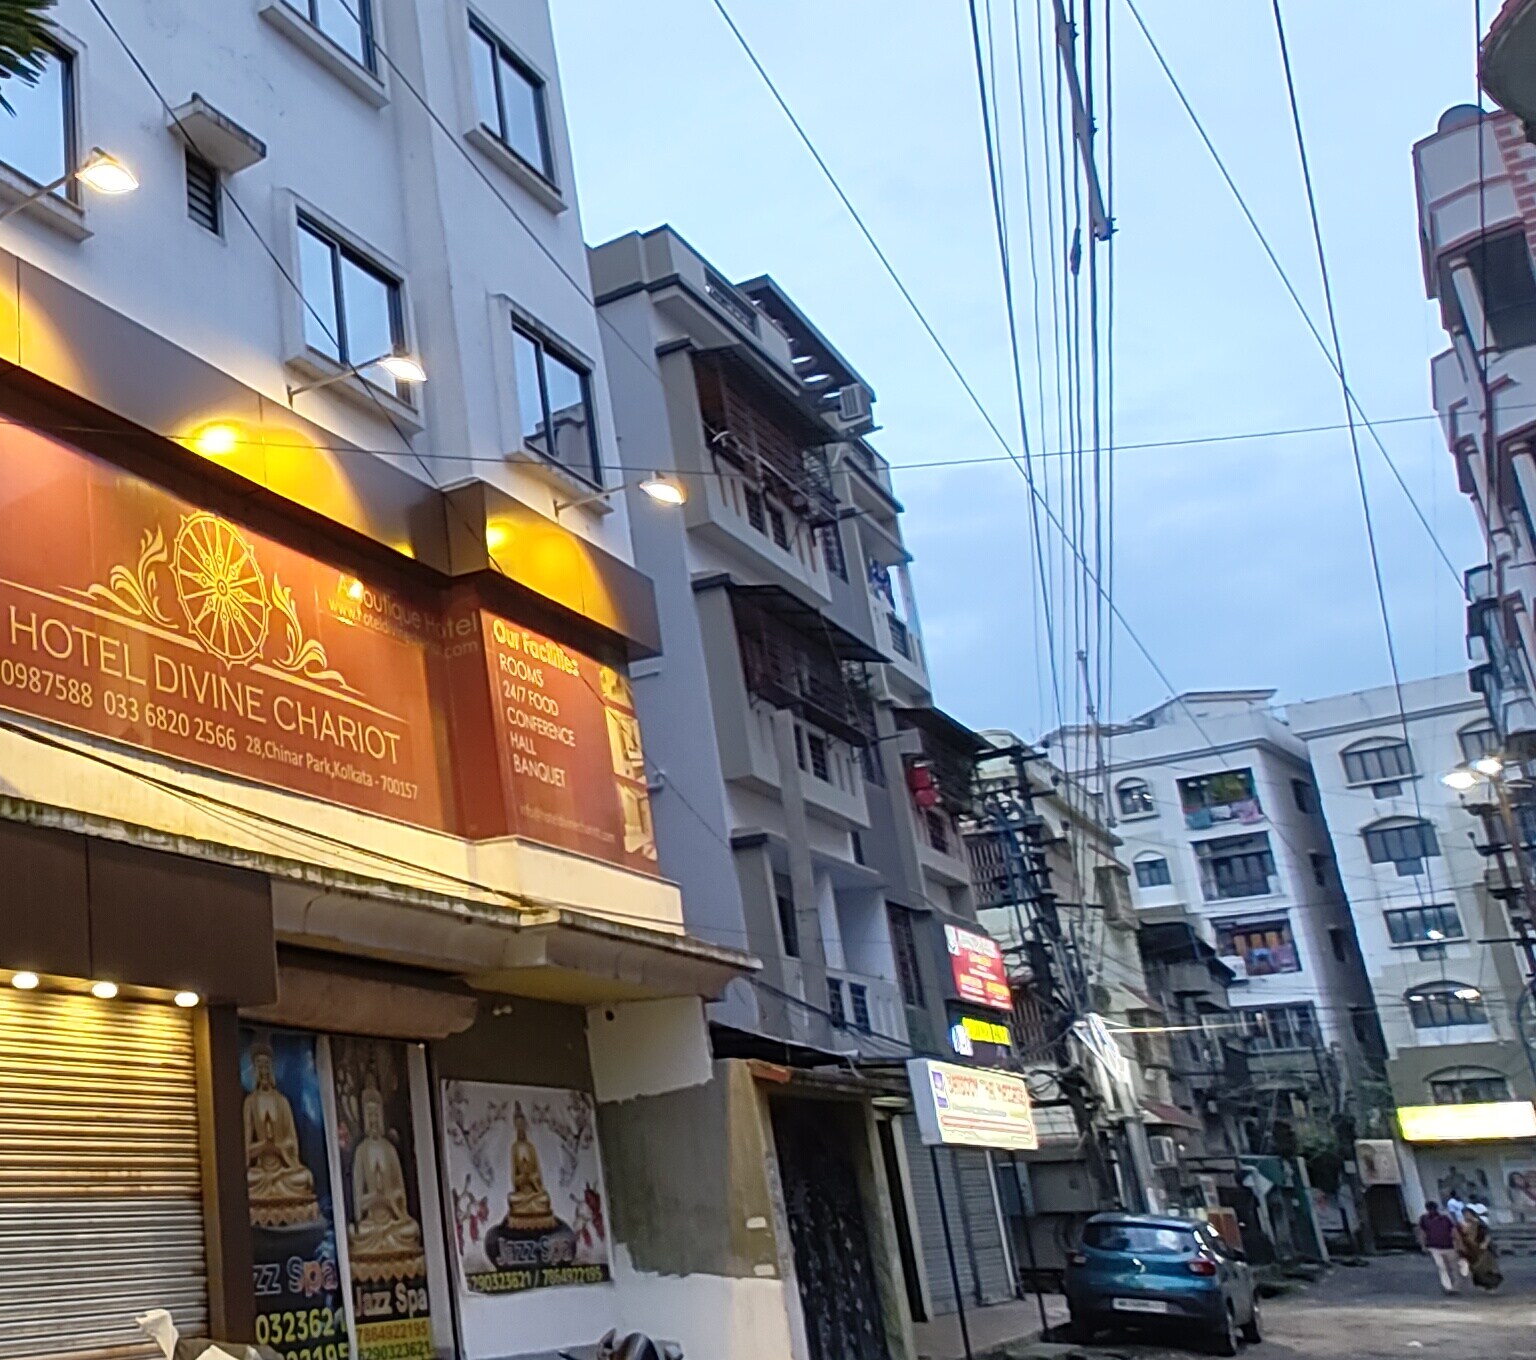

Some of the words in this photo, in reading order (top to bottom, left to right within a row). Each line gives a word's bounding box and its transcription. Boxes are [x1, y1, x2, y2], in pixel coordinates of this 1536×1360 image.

[353, 584, 420, 629] outique
[424, 611, 478, 640] Hotel
[493, 619, 520, 651] Our
[522, 632, 580, 677] Facilities
[9, 605, 146, 686] HOTEL
[153, 653, 266, 724] DIVINE
[273, 695, 400, 765] CHARIOT
[499, 653, 544, 688] ROOMS
[502, 680, 526, 703] 24/7
[527, 691, 560, 717] FOOD
[103, 690, 139, 722] 033
[145, 703, 189, 737] 6820
[193, 717, 237, 752] 2566
[381, 774, 418, 800] 700157
[507, 706, 576, 748] CONFERENCE
[510, 731, 537, 756] HALL
[513, 754, 566, 788] BANQUET
[496, 1237, 538, 1265] Jazz
[539, 1235, 573, 1265] Spa
[286, 1256, 339, 1297] Spa
[355, 1286, 393, 1317] Jazz
[395, 1282, 428, 1319] Spa
[255, 1307, 347, 1346] 0323621
